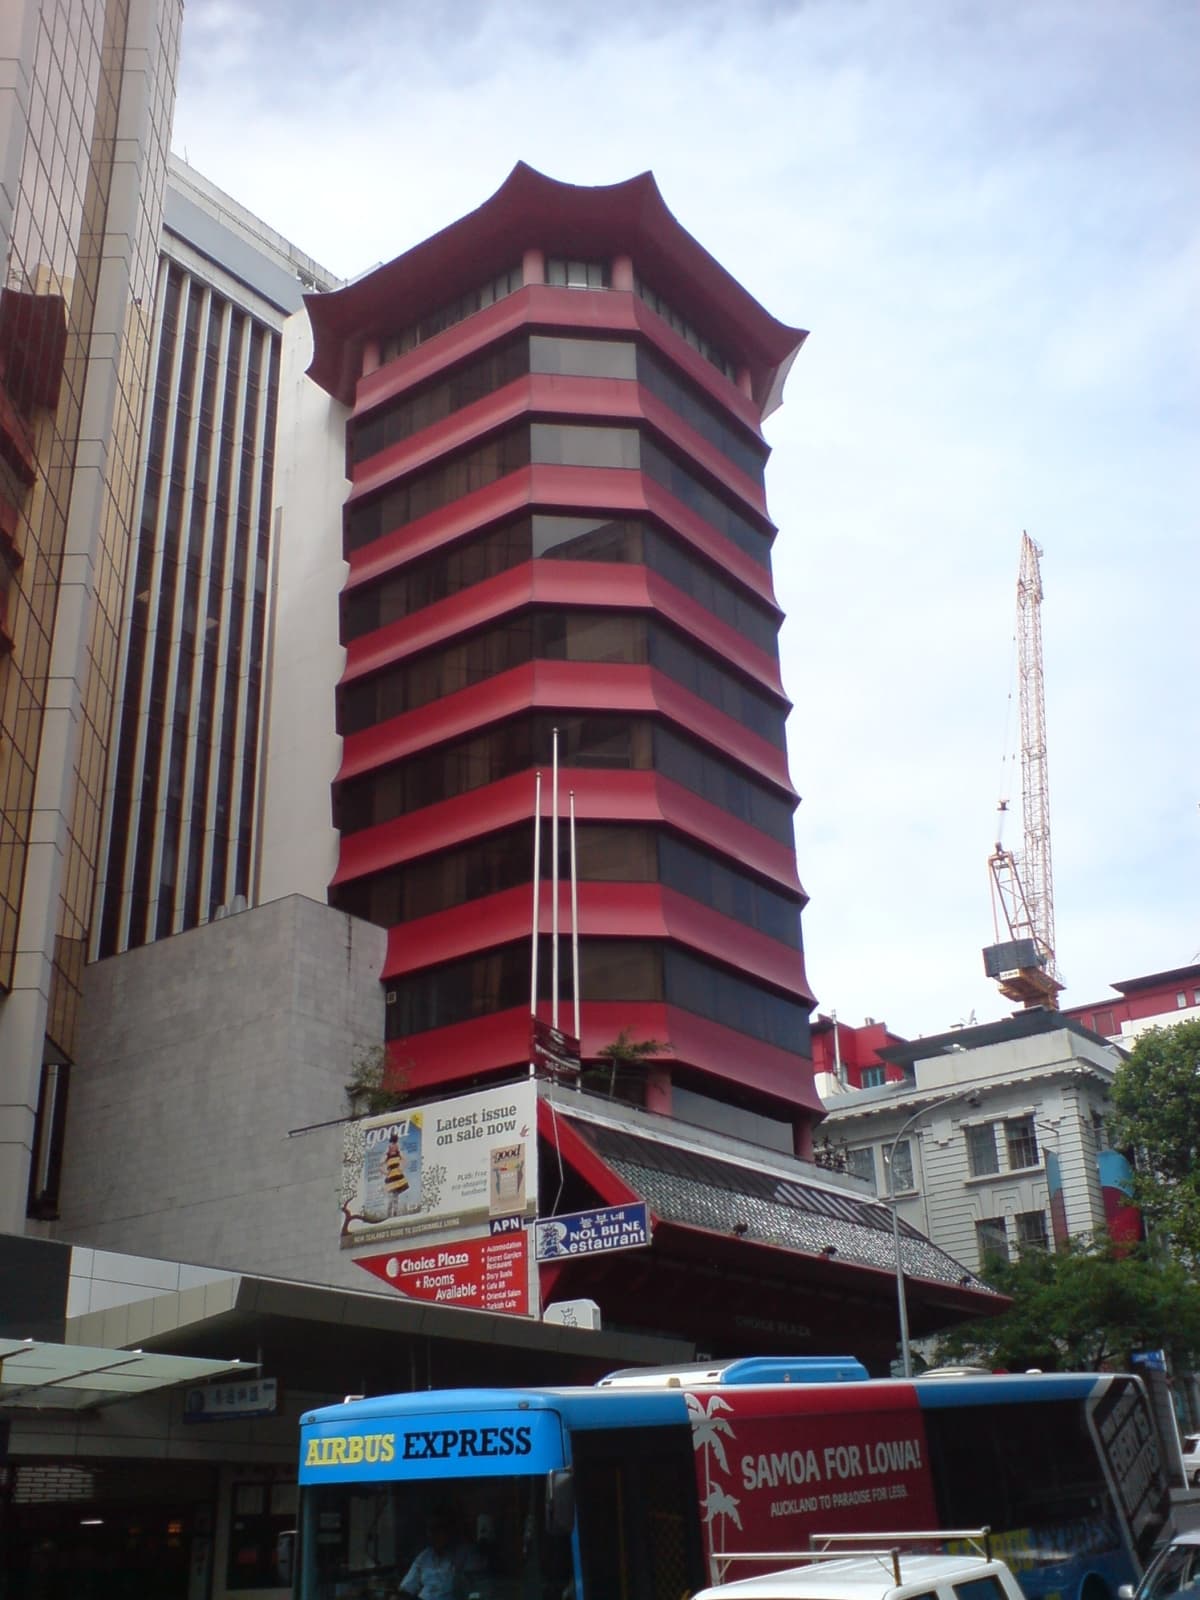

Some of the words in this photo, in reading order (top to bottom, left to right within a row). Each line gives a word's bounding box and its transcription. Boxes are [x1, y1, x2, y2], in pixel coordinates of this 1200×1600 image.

[436, 1112, 478, 1133] Latest
[482, 1105, 517, 1122] issue
[436, 1133, 453, 1146] on
[456, 1125, 484, 1142] sale
[486, 1120, 516, 1136] now
[494, 1144, 521, 1163] good
[492, 1217, 520, 1233] APN
[570, 1229, 599, 1241] NOL
[602, 1223, 620, 1236] BU
[622, 1220, 641, 1232] NE
[401, 1256, 436, 1273] Choice
[437, 1252, 469, 1267] Plaza
[422, 1274, 455, 1289] Rooms
[435, 1283, 478, 1301] Available
[304, 1433, 396, 1466] AIRBUS
[402, 1426, 532, 1460] EXPRESS
[741, 1450, 821, 1490] SAMOA
[823, 1445, 864, 1480] FOR
[865, 1440, 922, 1474] LOWA!
[770, 1496, 818, 1518] AUCKLAND
[818, 1494, 832, 1509] TO
[833, 1489, 872, 1508] PARADISE
[871, 1486, 887, 1501] FOR
